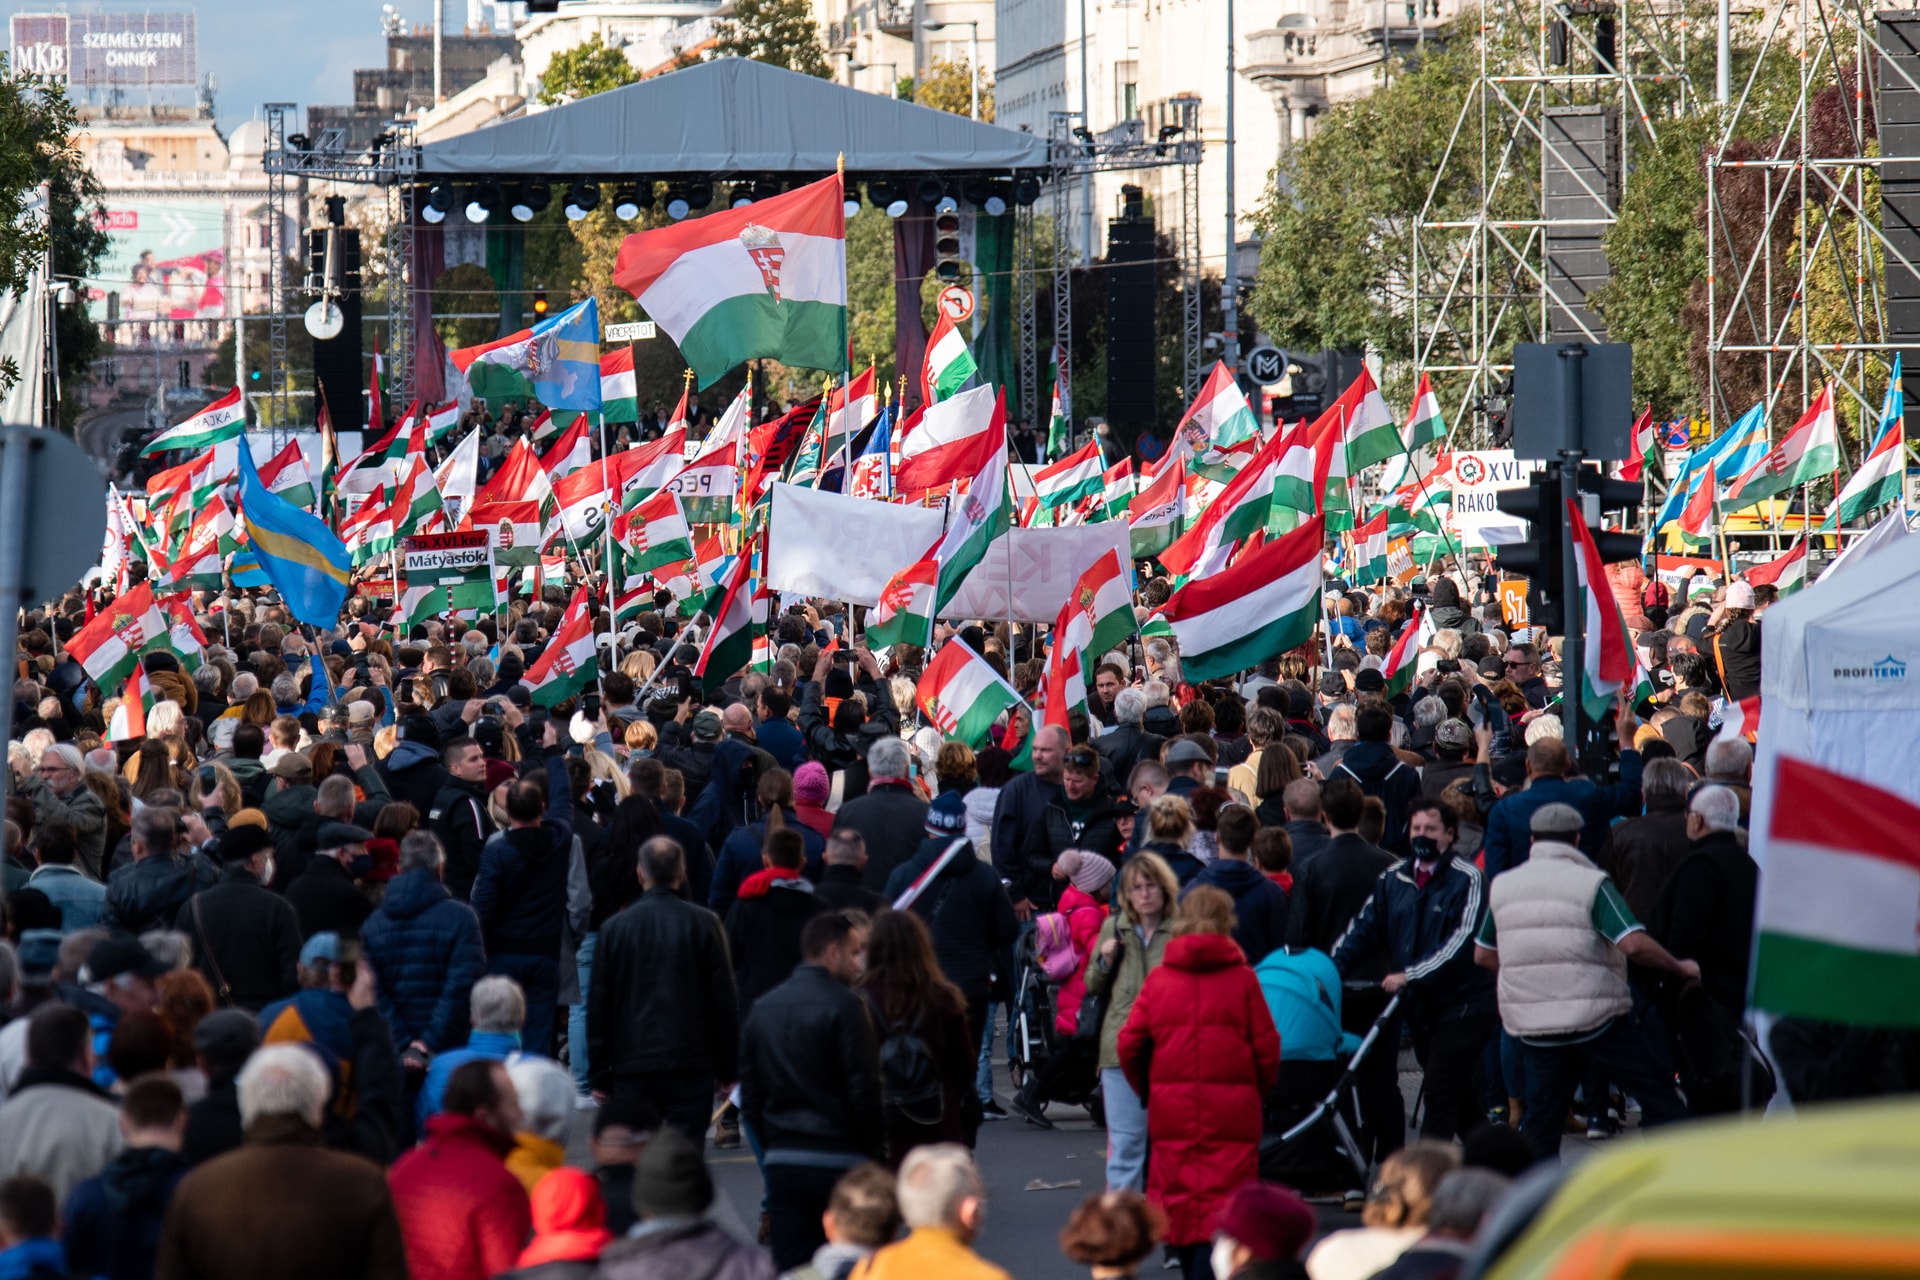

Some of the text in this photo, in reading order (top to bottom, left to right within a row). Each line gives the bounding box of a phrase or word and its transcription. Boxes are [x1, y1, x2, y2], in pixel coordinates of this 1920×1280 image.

[83, 32, 182, 48] SZEMÉLYESEN
[17, 42, 65, 73] MKB
[194, 411, 232, 429] RAJKA
[1488, 461, 1526, 482] XVI.
[1457, 490, 1495, 513] RÁKO
[1833, 667, 1906, 678] PROFITENT
